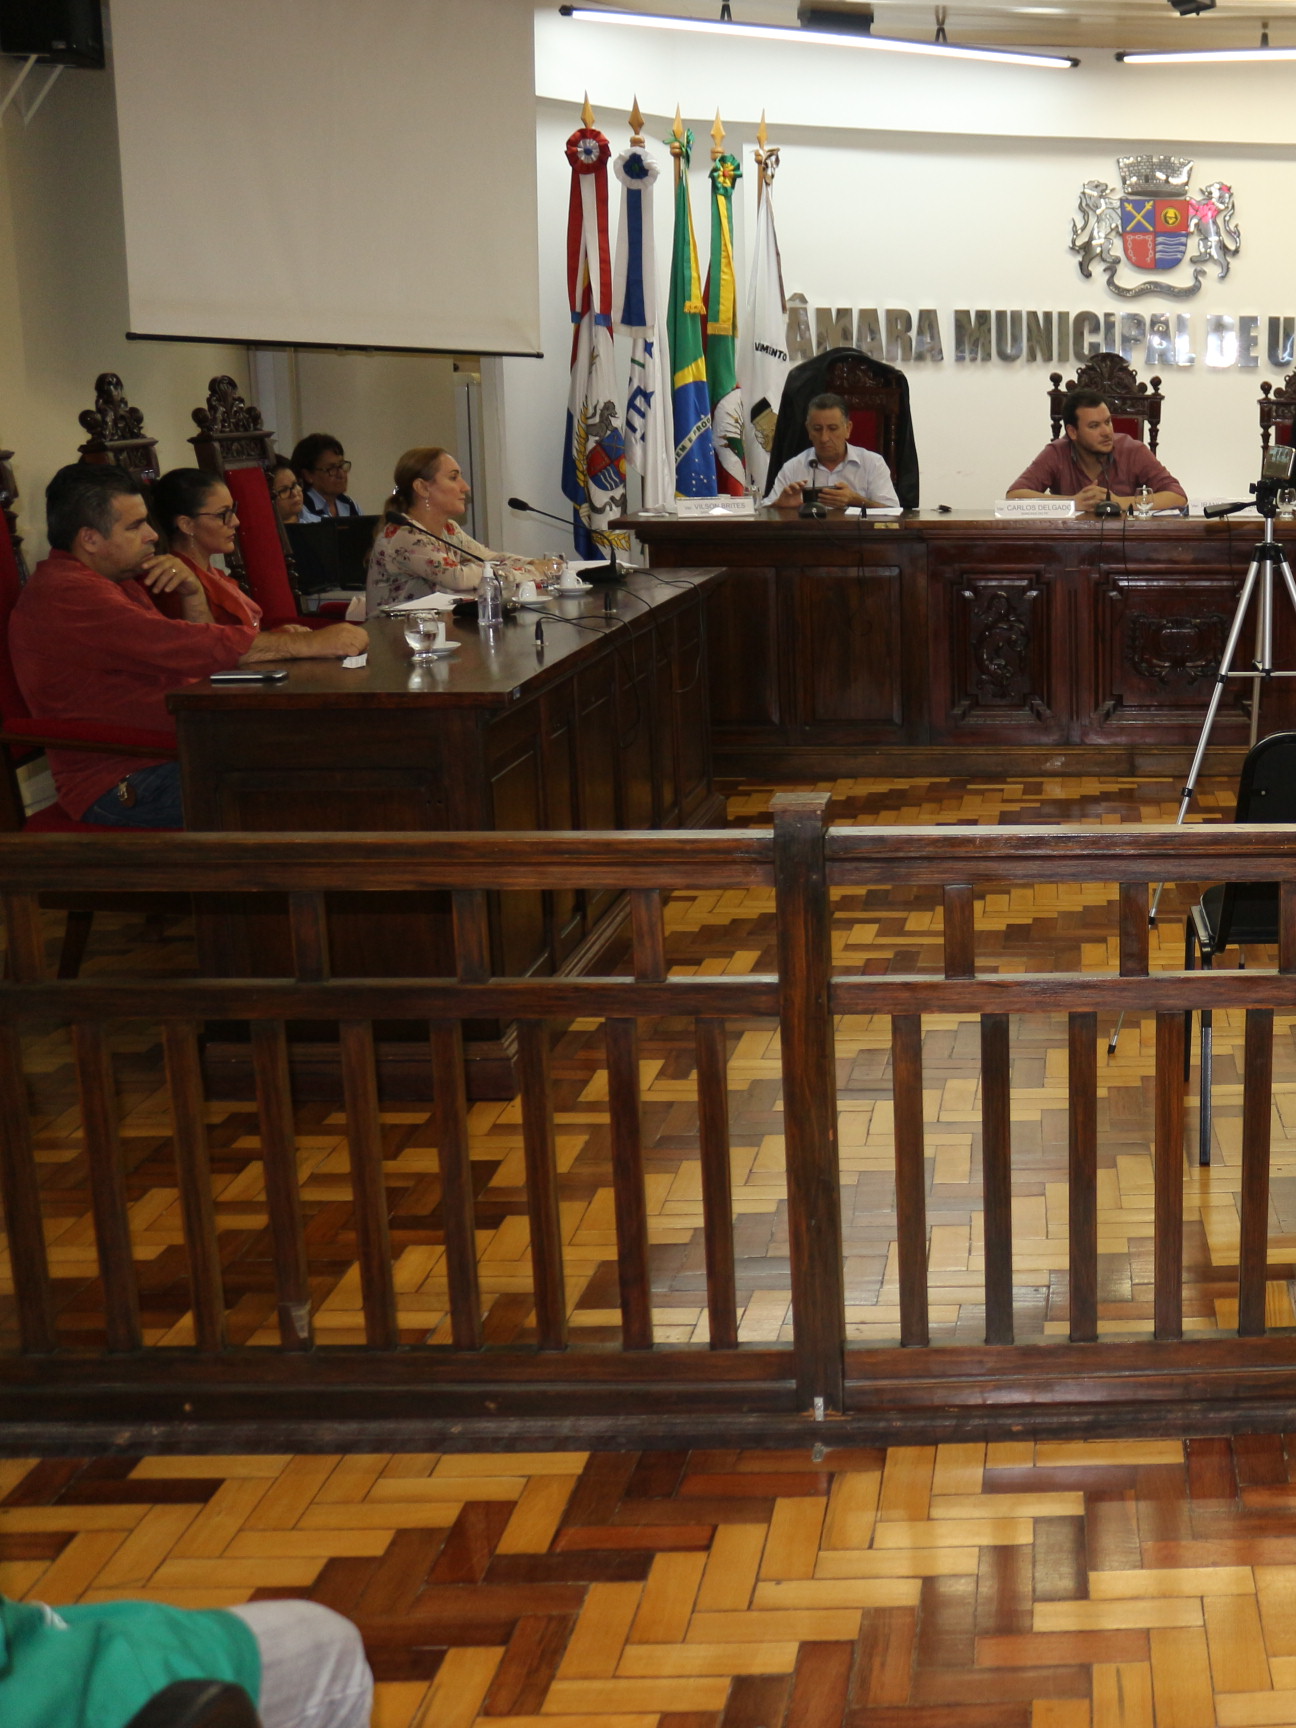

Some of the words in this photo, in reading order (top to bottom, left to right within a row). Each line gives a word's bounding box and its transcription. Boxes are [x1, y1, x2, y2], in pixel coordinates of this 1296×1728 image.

[786, 292, 944, 362] ÂMARA
[953, 309, 1196, 367] MUNICIPAL
[1205, 314, 1260, 368] DE
